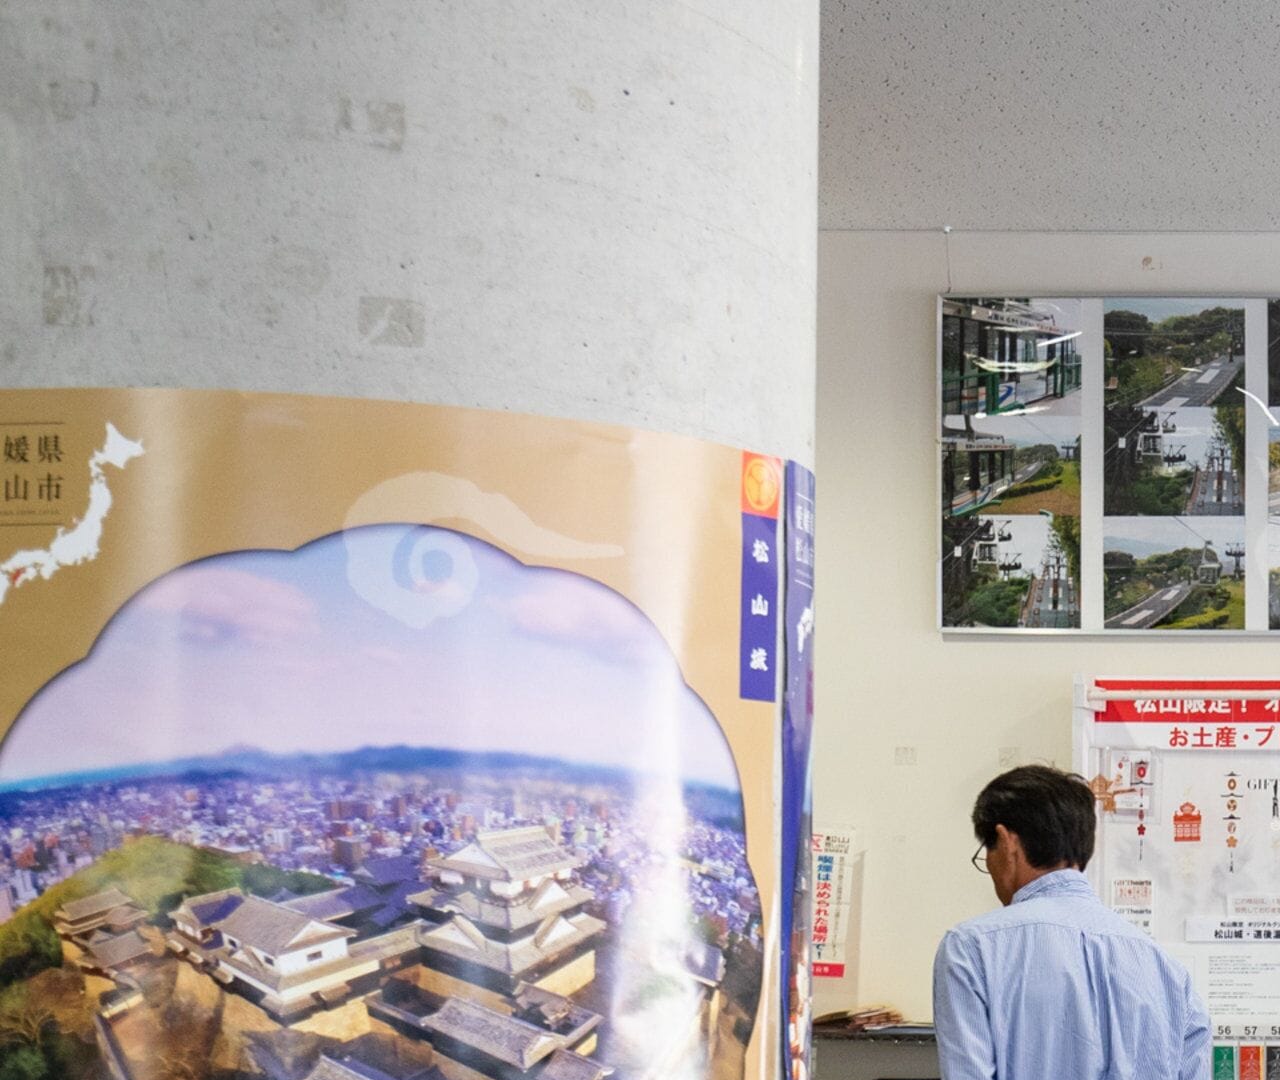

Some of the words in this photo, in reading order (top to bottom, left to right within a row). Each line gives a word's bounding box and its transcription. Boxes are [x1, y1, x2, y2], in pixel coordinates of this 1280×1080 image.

[5, 473, 63, 501] 山市
[749, 538, 770, 672] 松山城
[1217, 1026, 1232, 1036] 56
[1244, 1026, 1258, 1036] 57
